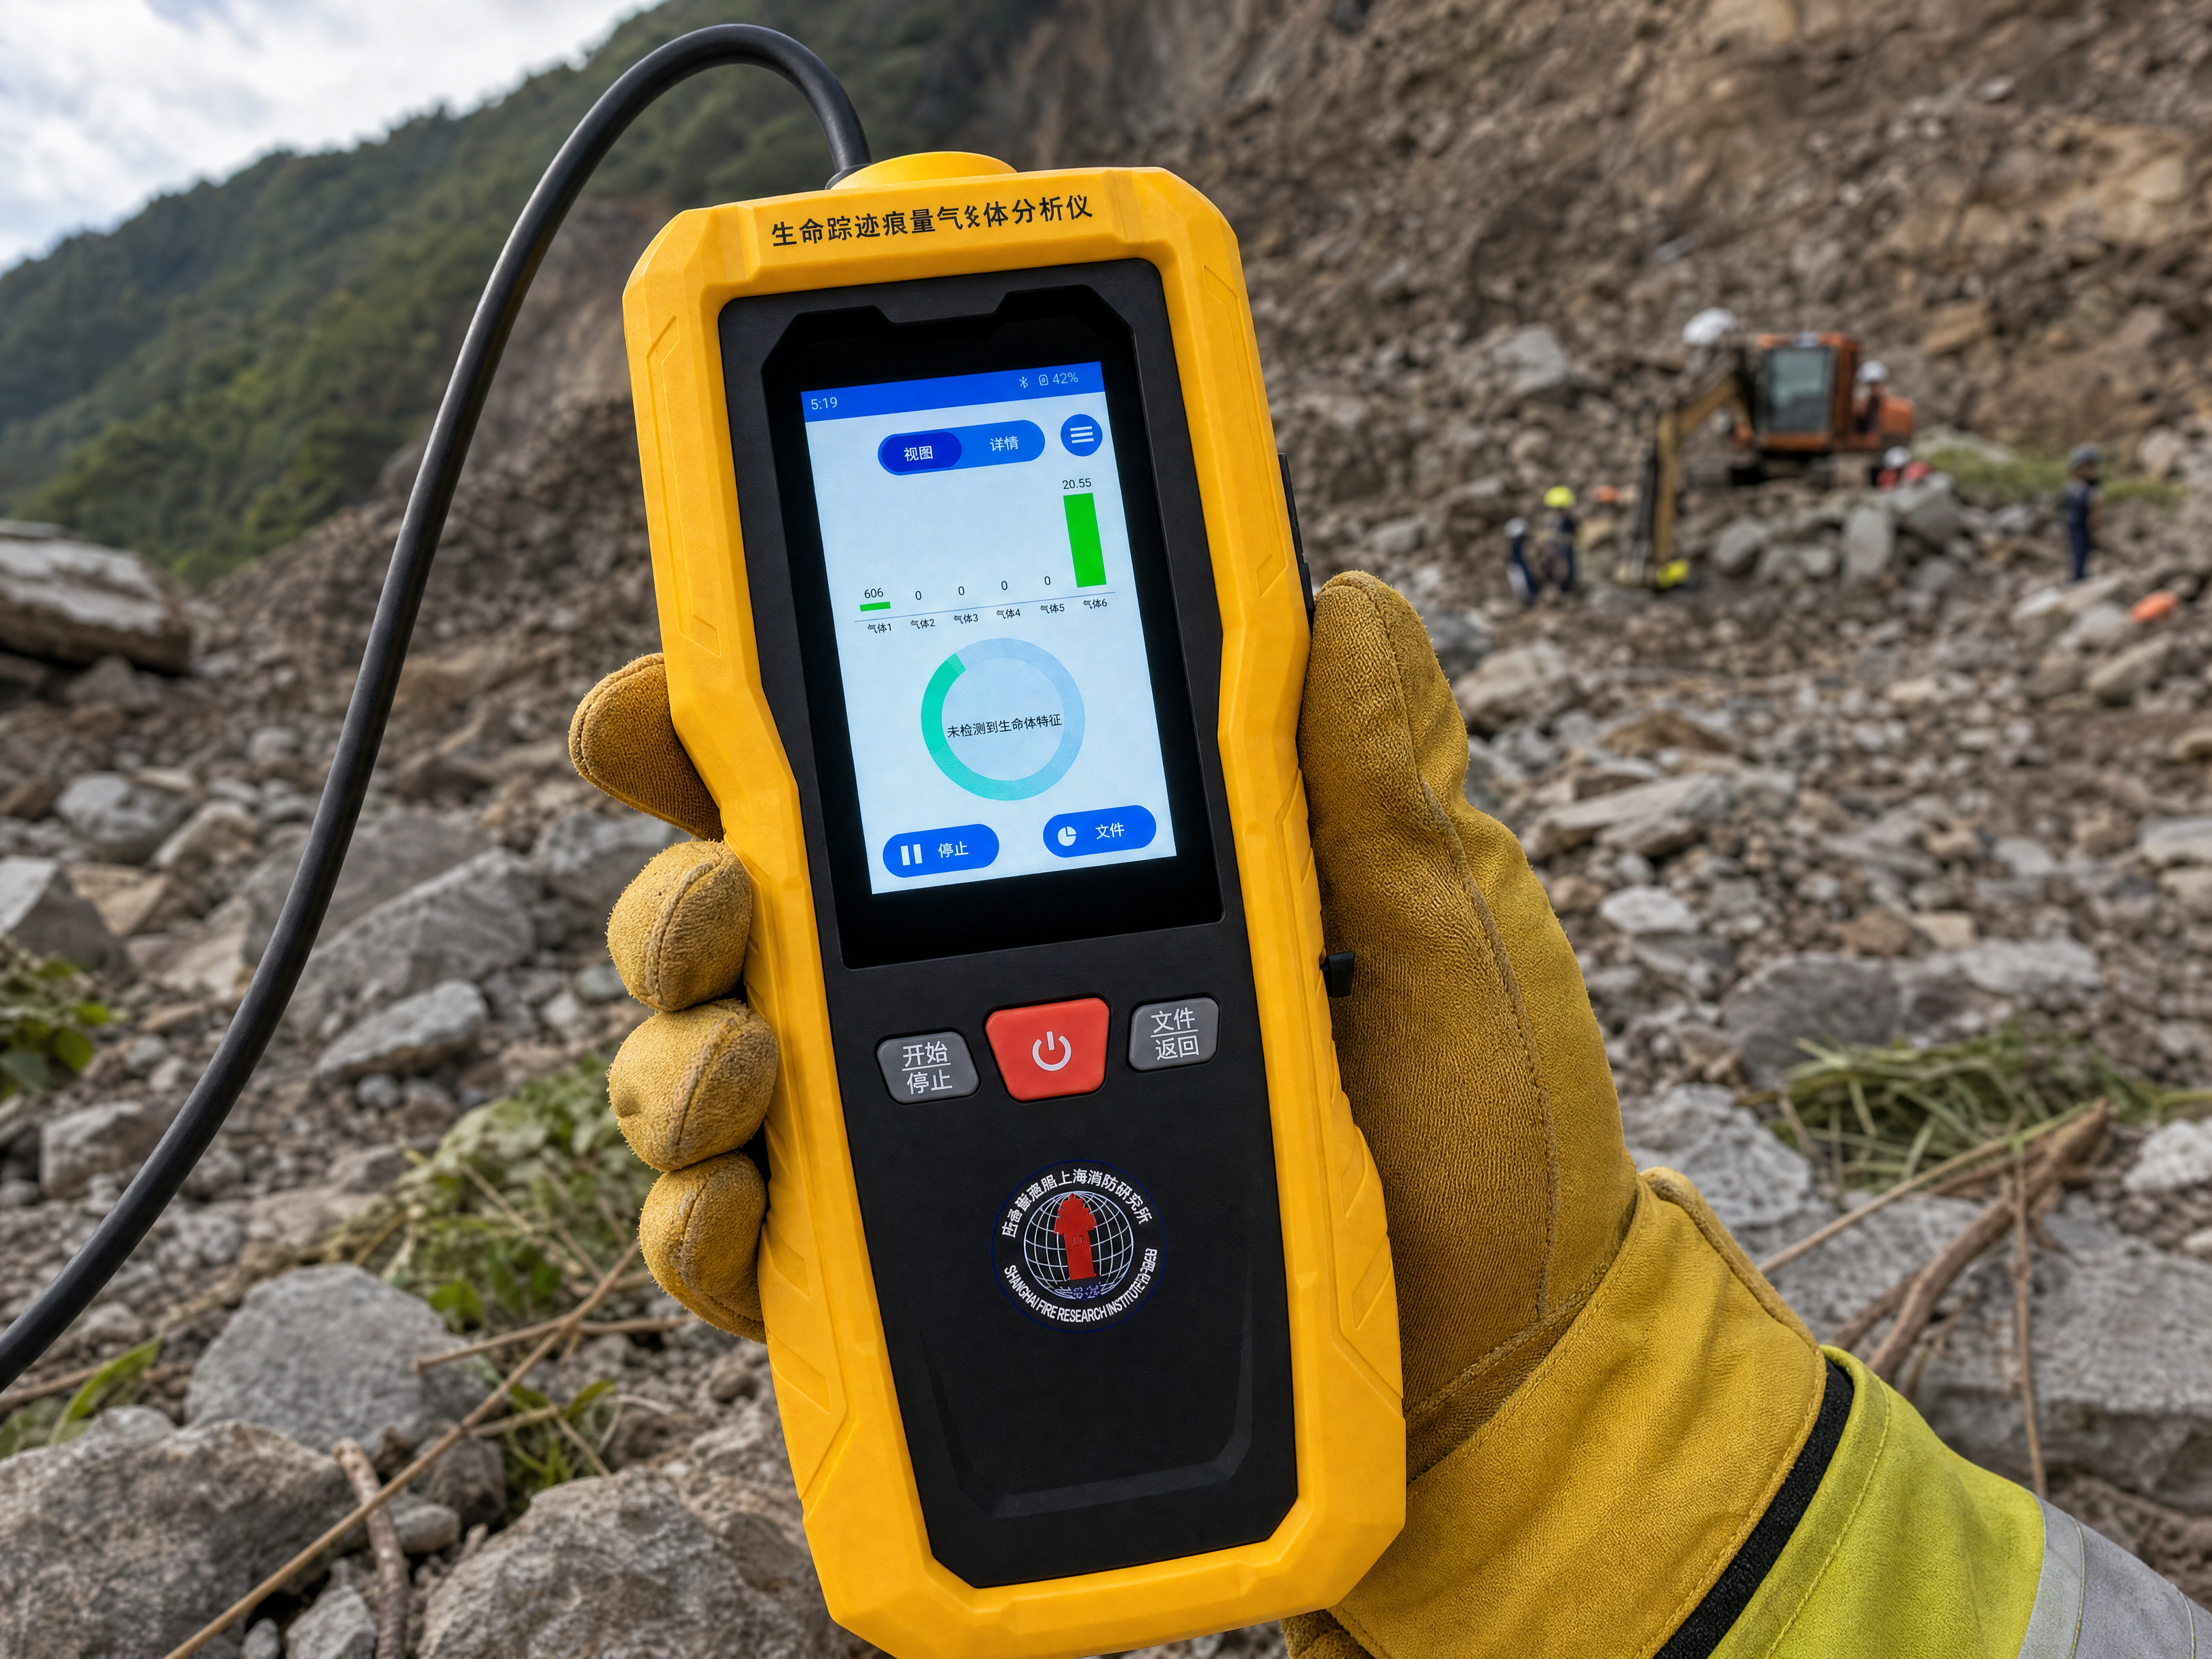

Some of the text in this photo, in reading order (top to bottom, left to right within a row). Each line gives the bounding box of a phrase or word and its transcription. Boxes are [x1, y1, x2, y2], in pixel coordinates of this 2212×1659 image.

[1052, 372, 1079, 384] 42%
[811, 396, 838, 410] 5:19
[903, 445, 933, 462] 视图
[989, 436, 1019, 451] 详情
[1062, 478, 1092, 490] 20.55
[864, 575, 1051, 600] 606 0 0 0 0
[867, 598, 1108, 634] 气体1 气体2 气体3 气体4 气体5 气体6
[947, 714, 1063, 739] 未检测到生命体特征
[1095, 822, 1125, 840] 文件
[938, 841, 969, 859] 停止
[1151, 1007, 1196, 1033] 文件
[902, 1040, 948, 1067] 开始
[1155, 1035, 1200, 1061] 返回
[906, 1069, 954, 1095] 停止
[1004, 1265, 1040, 1309] SHANGHAI
[1036, 1299, 1058, 1319] FIRE
[1057, 1305, 1108, 1323] RESEARCH
